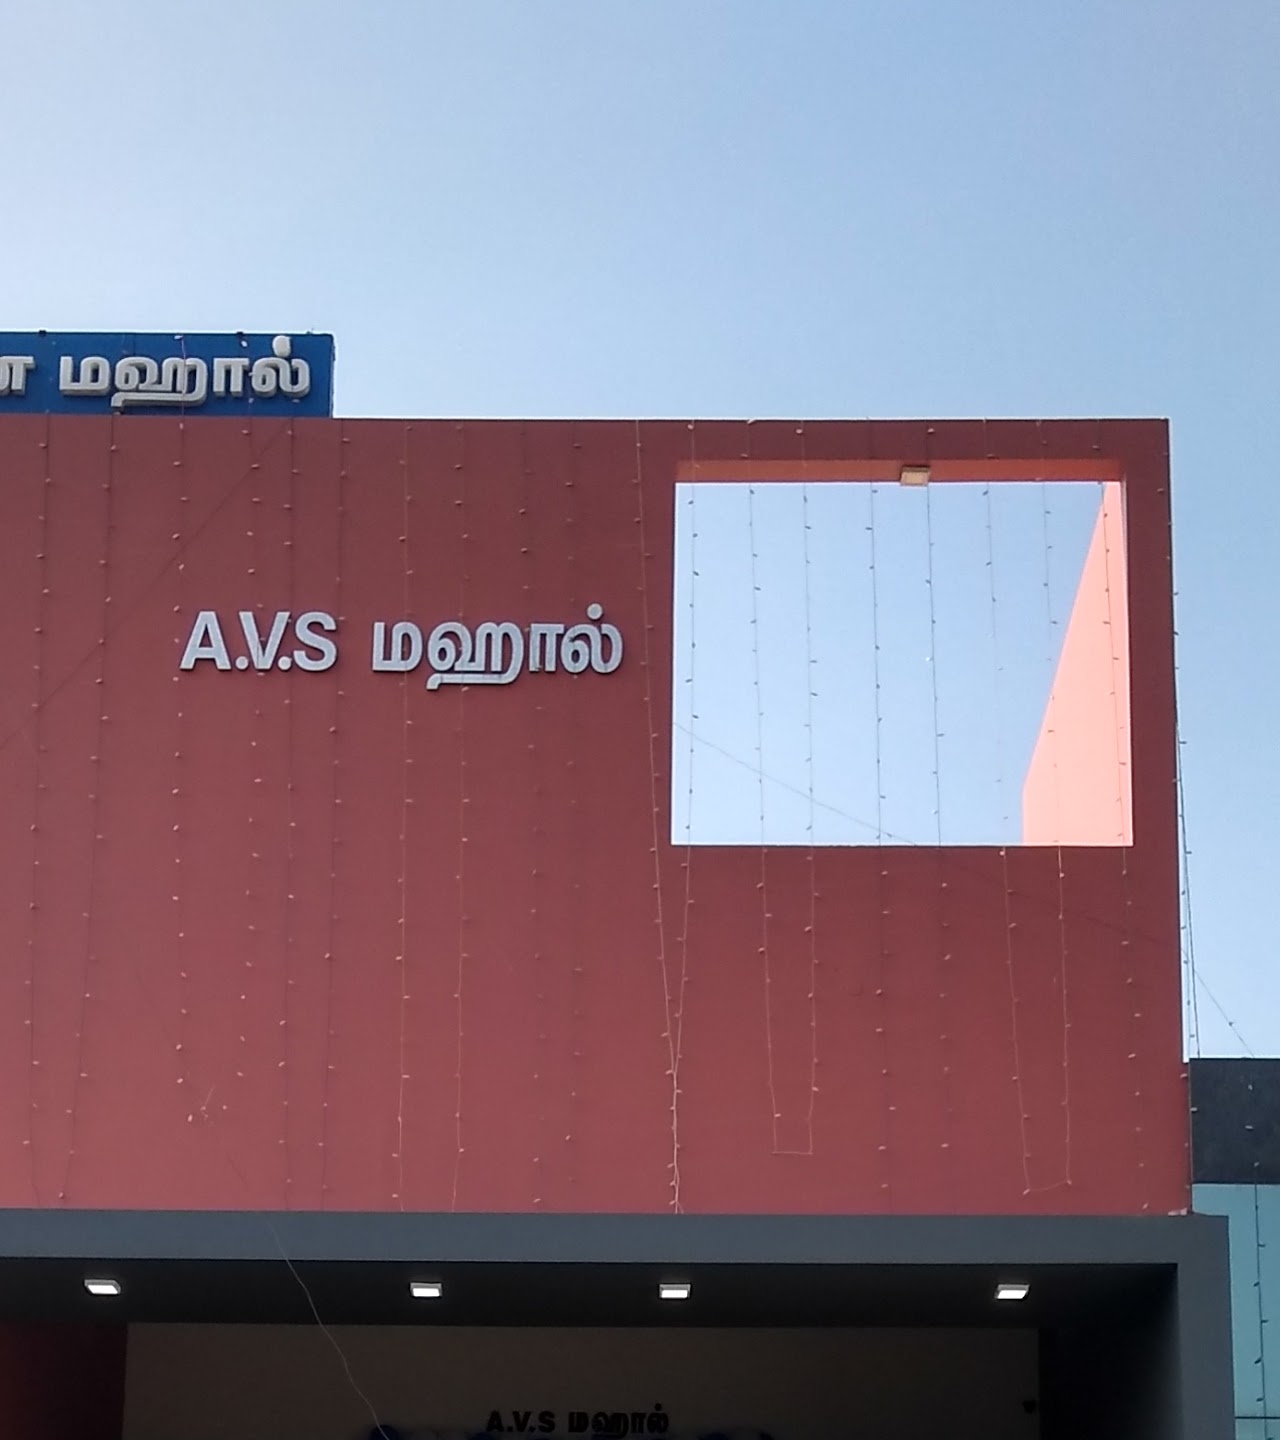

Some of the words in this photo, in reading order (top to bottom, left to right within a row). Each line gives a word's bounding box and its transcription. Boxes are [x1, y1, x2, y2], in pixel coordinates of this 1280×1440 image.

[59, 335, 311, 408] மஹால்
[179, 610, 338, 671] A.V.S
[372, 603, 624, 690] மஹால்
[486, 1410, 557, 1433] A.V.S
[568, 1402, 670, 1440] மஹால்
